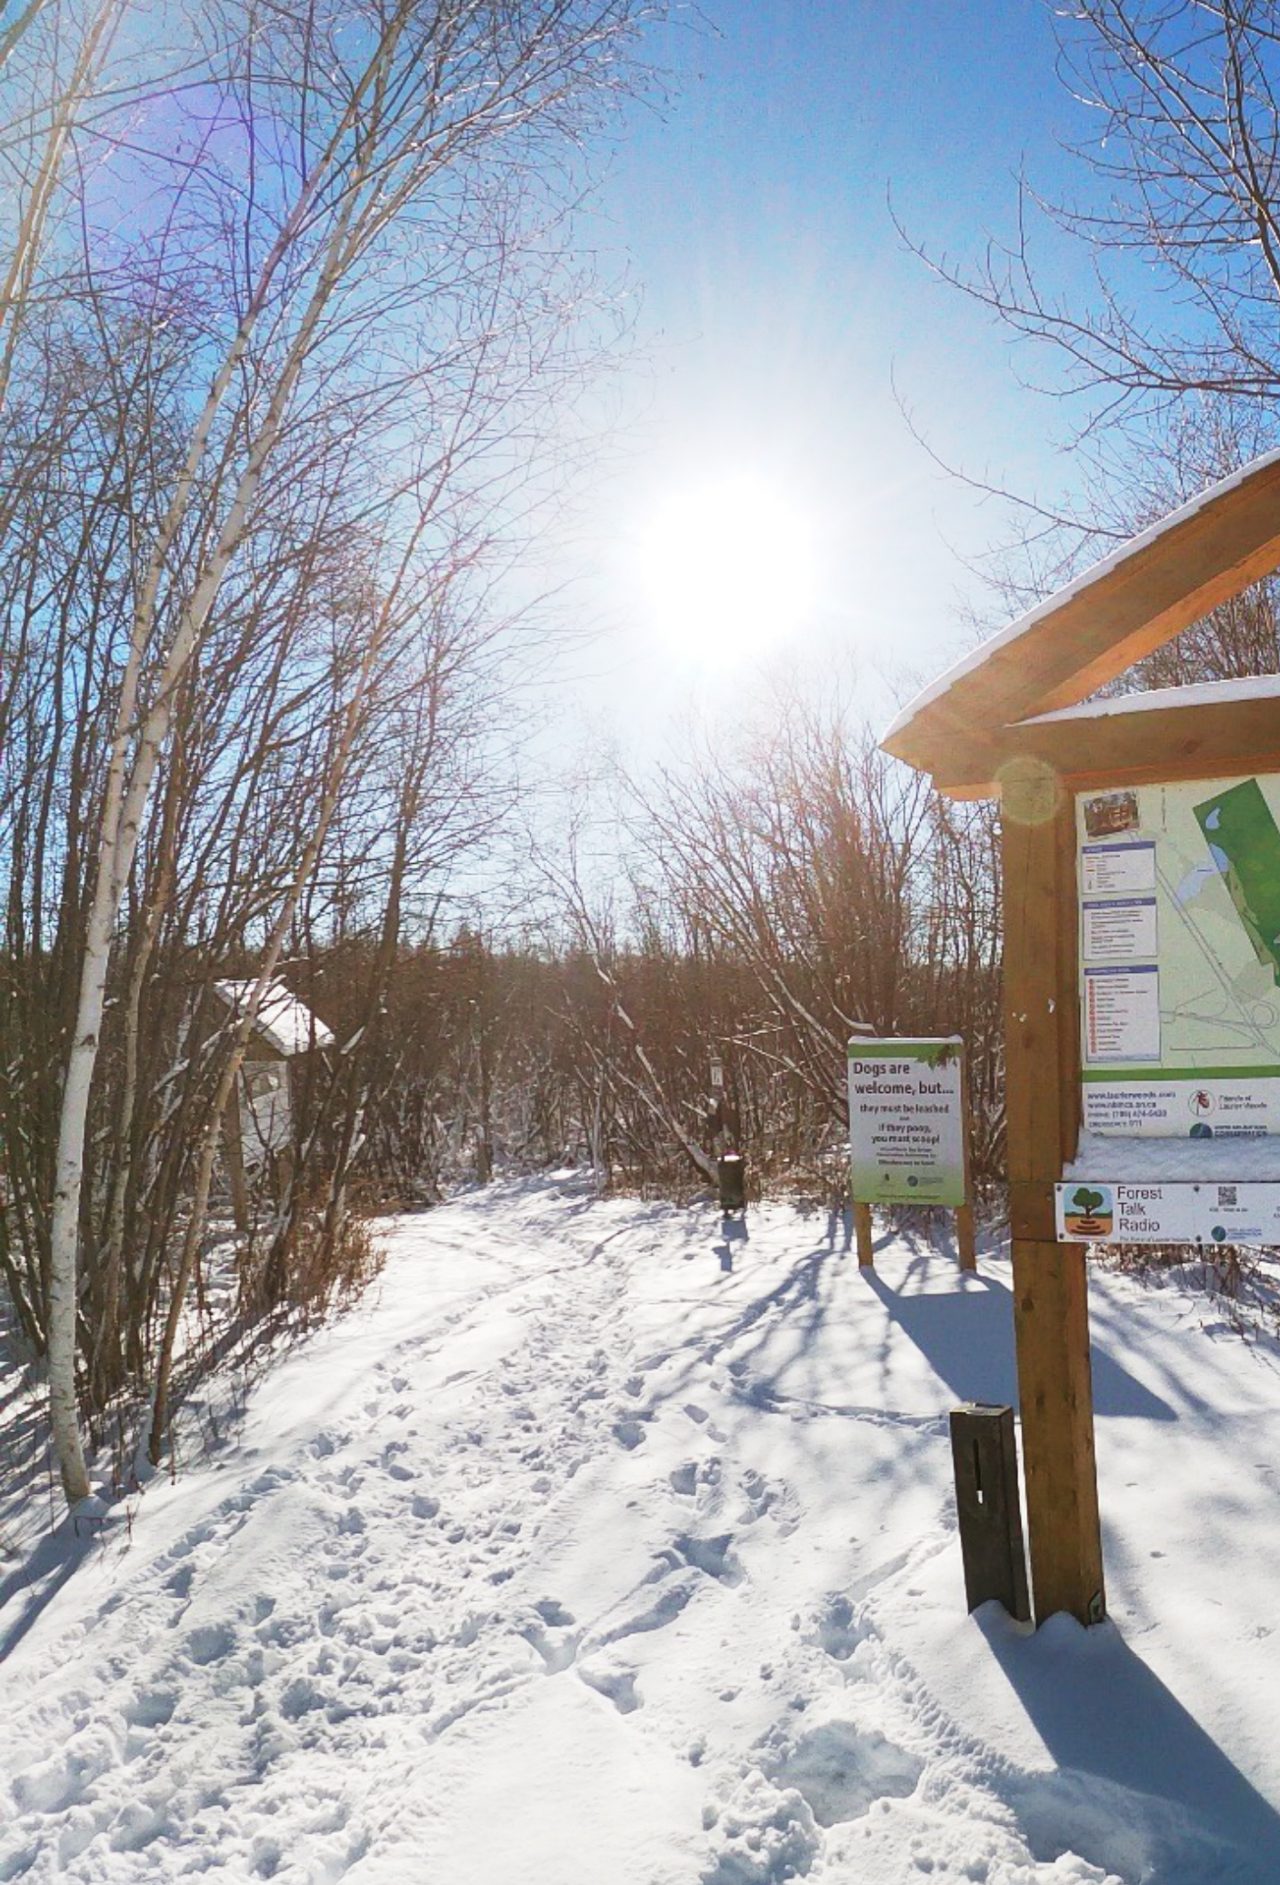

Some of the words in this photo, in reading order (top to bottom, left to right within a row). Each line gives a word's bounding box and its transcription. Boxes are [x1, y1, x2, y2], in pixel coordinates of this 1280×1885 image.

[853, 1062, 887, 1078] Dogs
[889, 1063, 910, 1074] are
[855, 1080, 916, 1096] welcome,
[919, 1080, 954, 1094] but...
[860, 1104, 879, 1115] they
[880, 1104, 901, 1113] must
[903, 1104, 914, 1113] be
[1117, 1186, 1163, 1200] Forest
[1117, 1202, 1146, 1216] Talk
[1119, 1218, 1160, 1232] Radio
